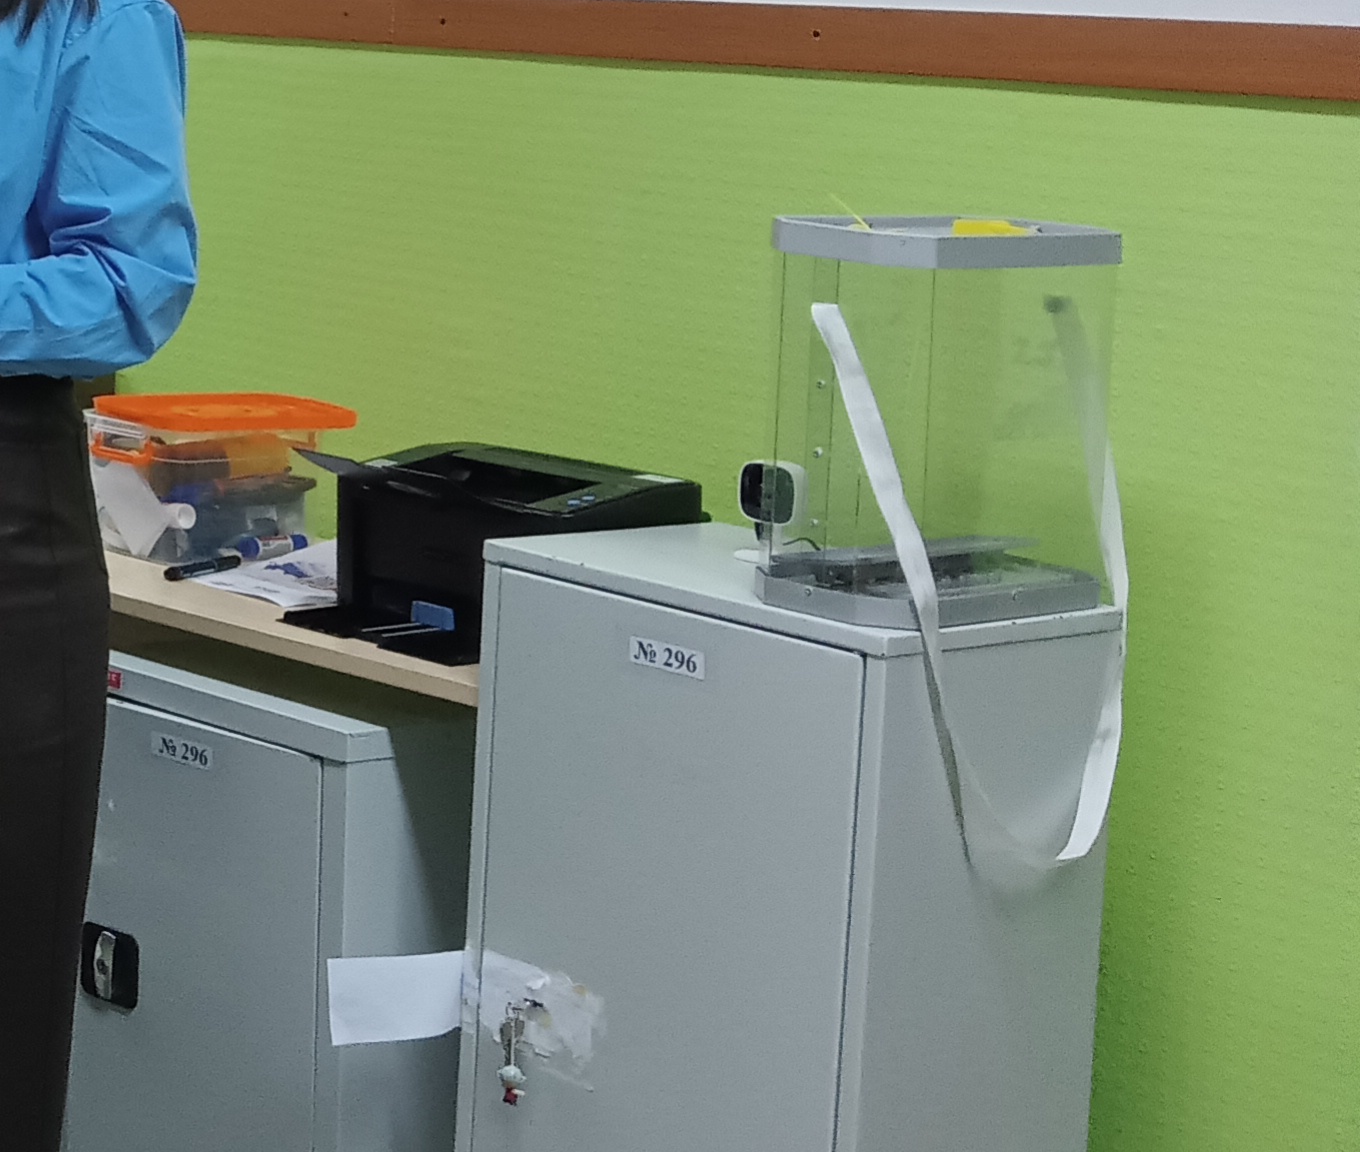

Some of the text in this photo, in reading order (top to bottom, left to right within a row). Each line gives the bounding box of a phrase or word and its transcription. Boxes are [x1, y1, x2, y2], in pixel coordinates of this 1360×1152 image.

[633, 640, 698, 674] № 296
[158, 737, 209, 767] № 296
